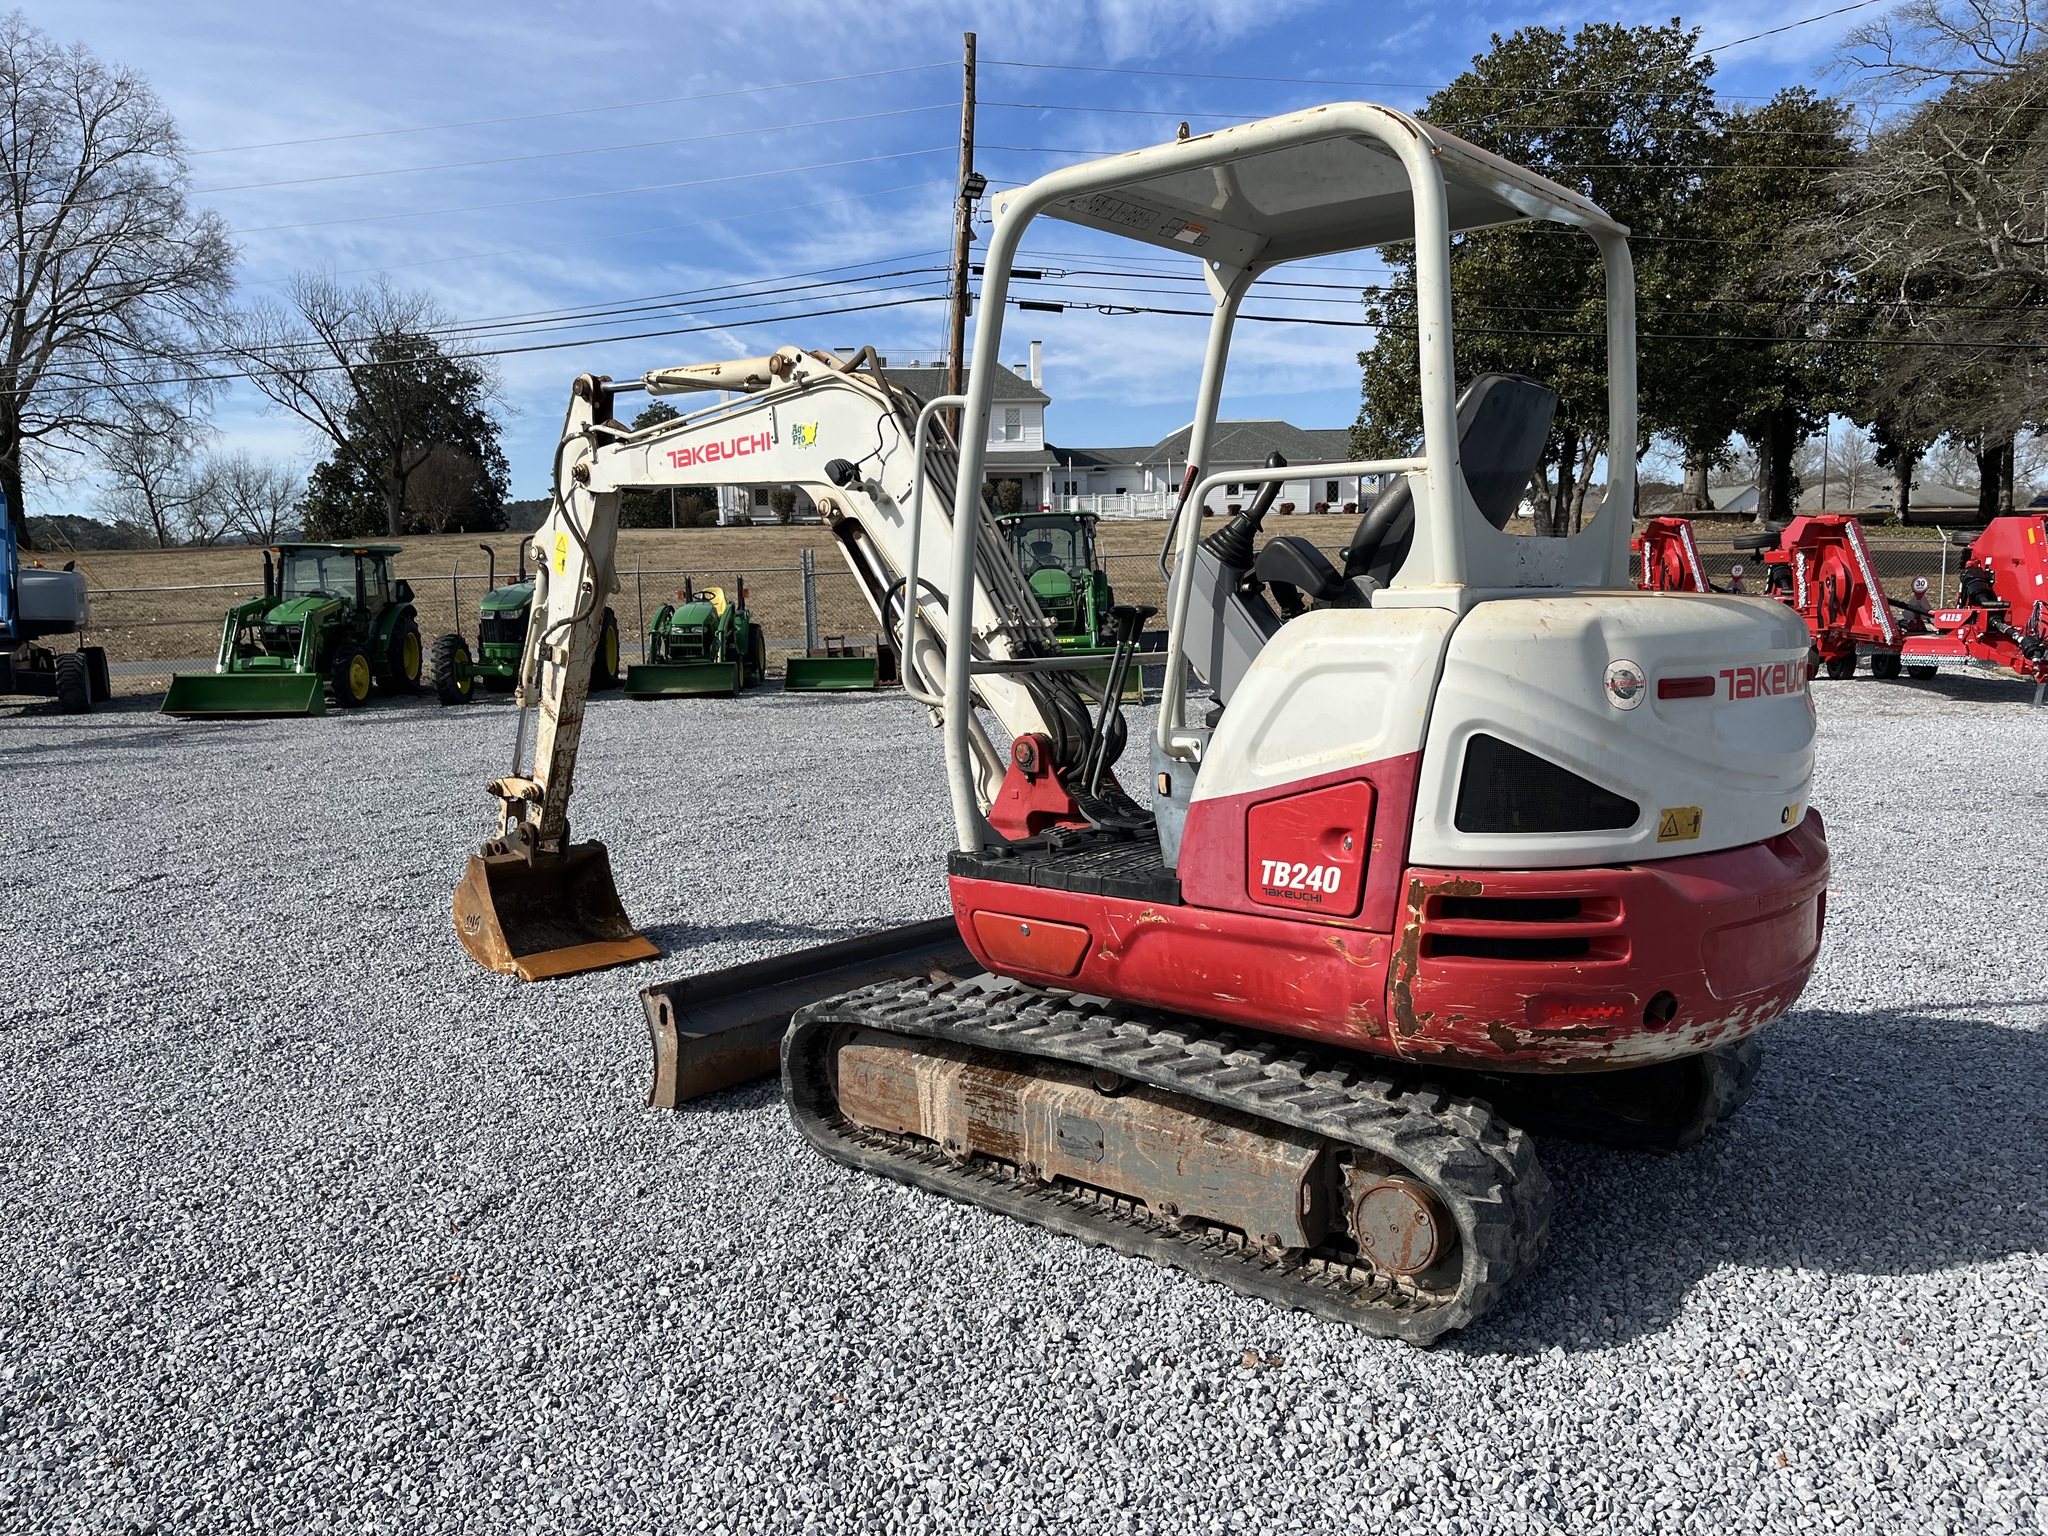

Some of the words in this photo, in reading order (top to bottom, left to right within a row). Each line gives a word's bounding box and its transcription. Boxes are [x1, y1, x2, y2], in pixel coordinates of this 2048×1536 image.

[667, 431, 771, 468] TAKEUCHI
[793, 435, 805, 445] Pro
[1939, 613, 1962, 622] 4115
[1719, 661, 1807, 701] TAKEUC
[1261, 860, 1341, 894] TB240
[1262, 887, 1322, 902] TAKEUCHI
